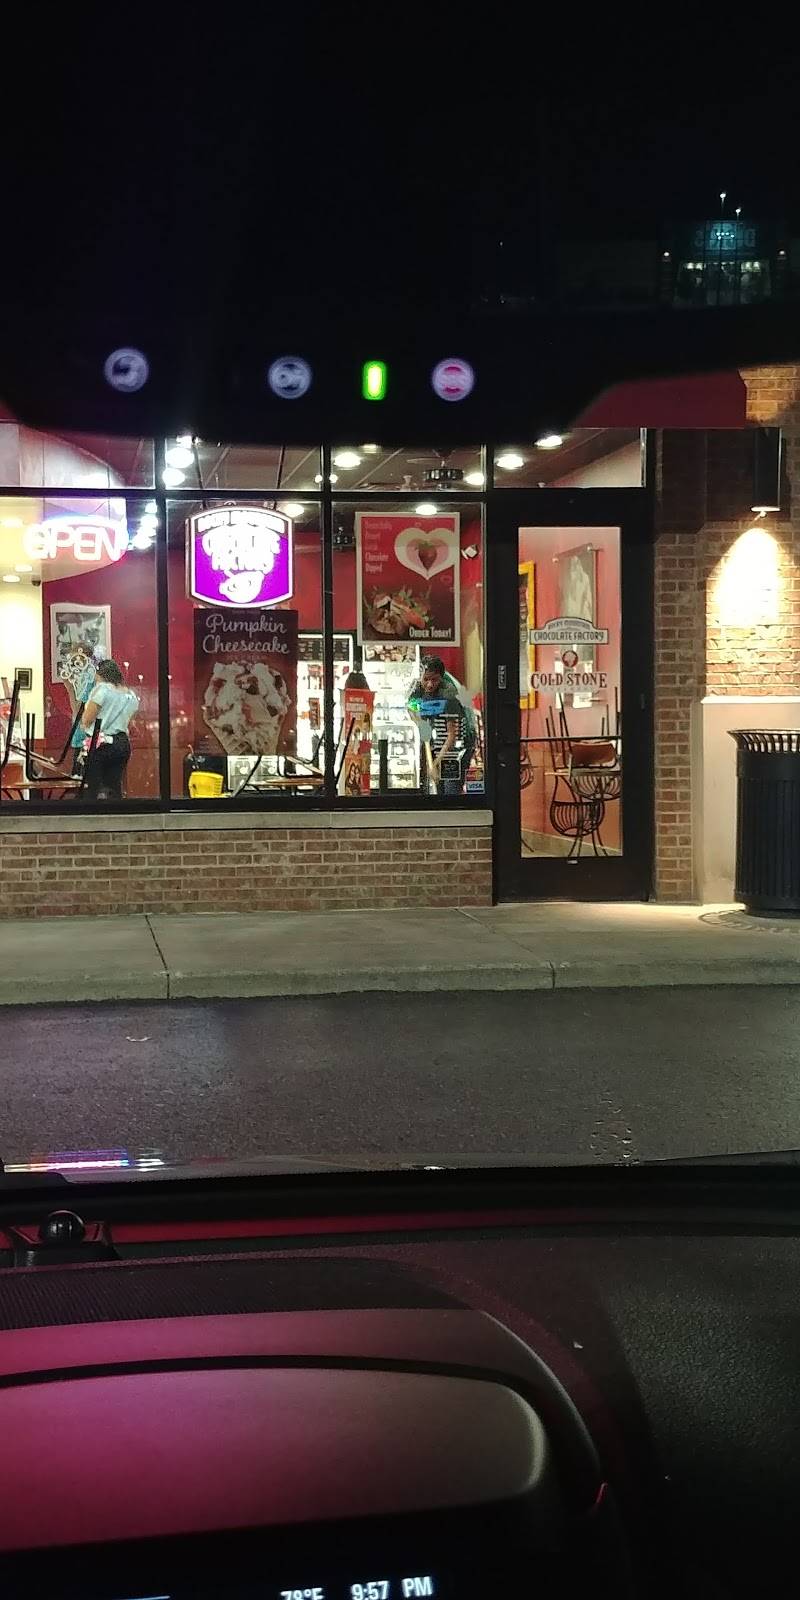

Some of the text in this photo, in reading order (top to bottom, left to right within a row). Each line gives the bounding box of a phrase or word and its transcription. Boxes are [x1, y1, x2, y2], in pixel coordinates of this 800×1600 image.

[23, 524, 121, 561] OPEN
[206, 613, 287, 638] Pumpkin
[534, 631, 604, 641] CHOCOLATE FACTORY
[203, 634, 290, 654] Cheesecake
[530, 672, 608, 689] COLD STONE
[351, 1580, 389, 1600] 9:57
[402, 1576, 433, 1598] PM
